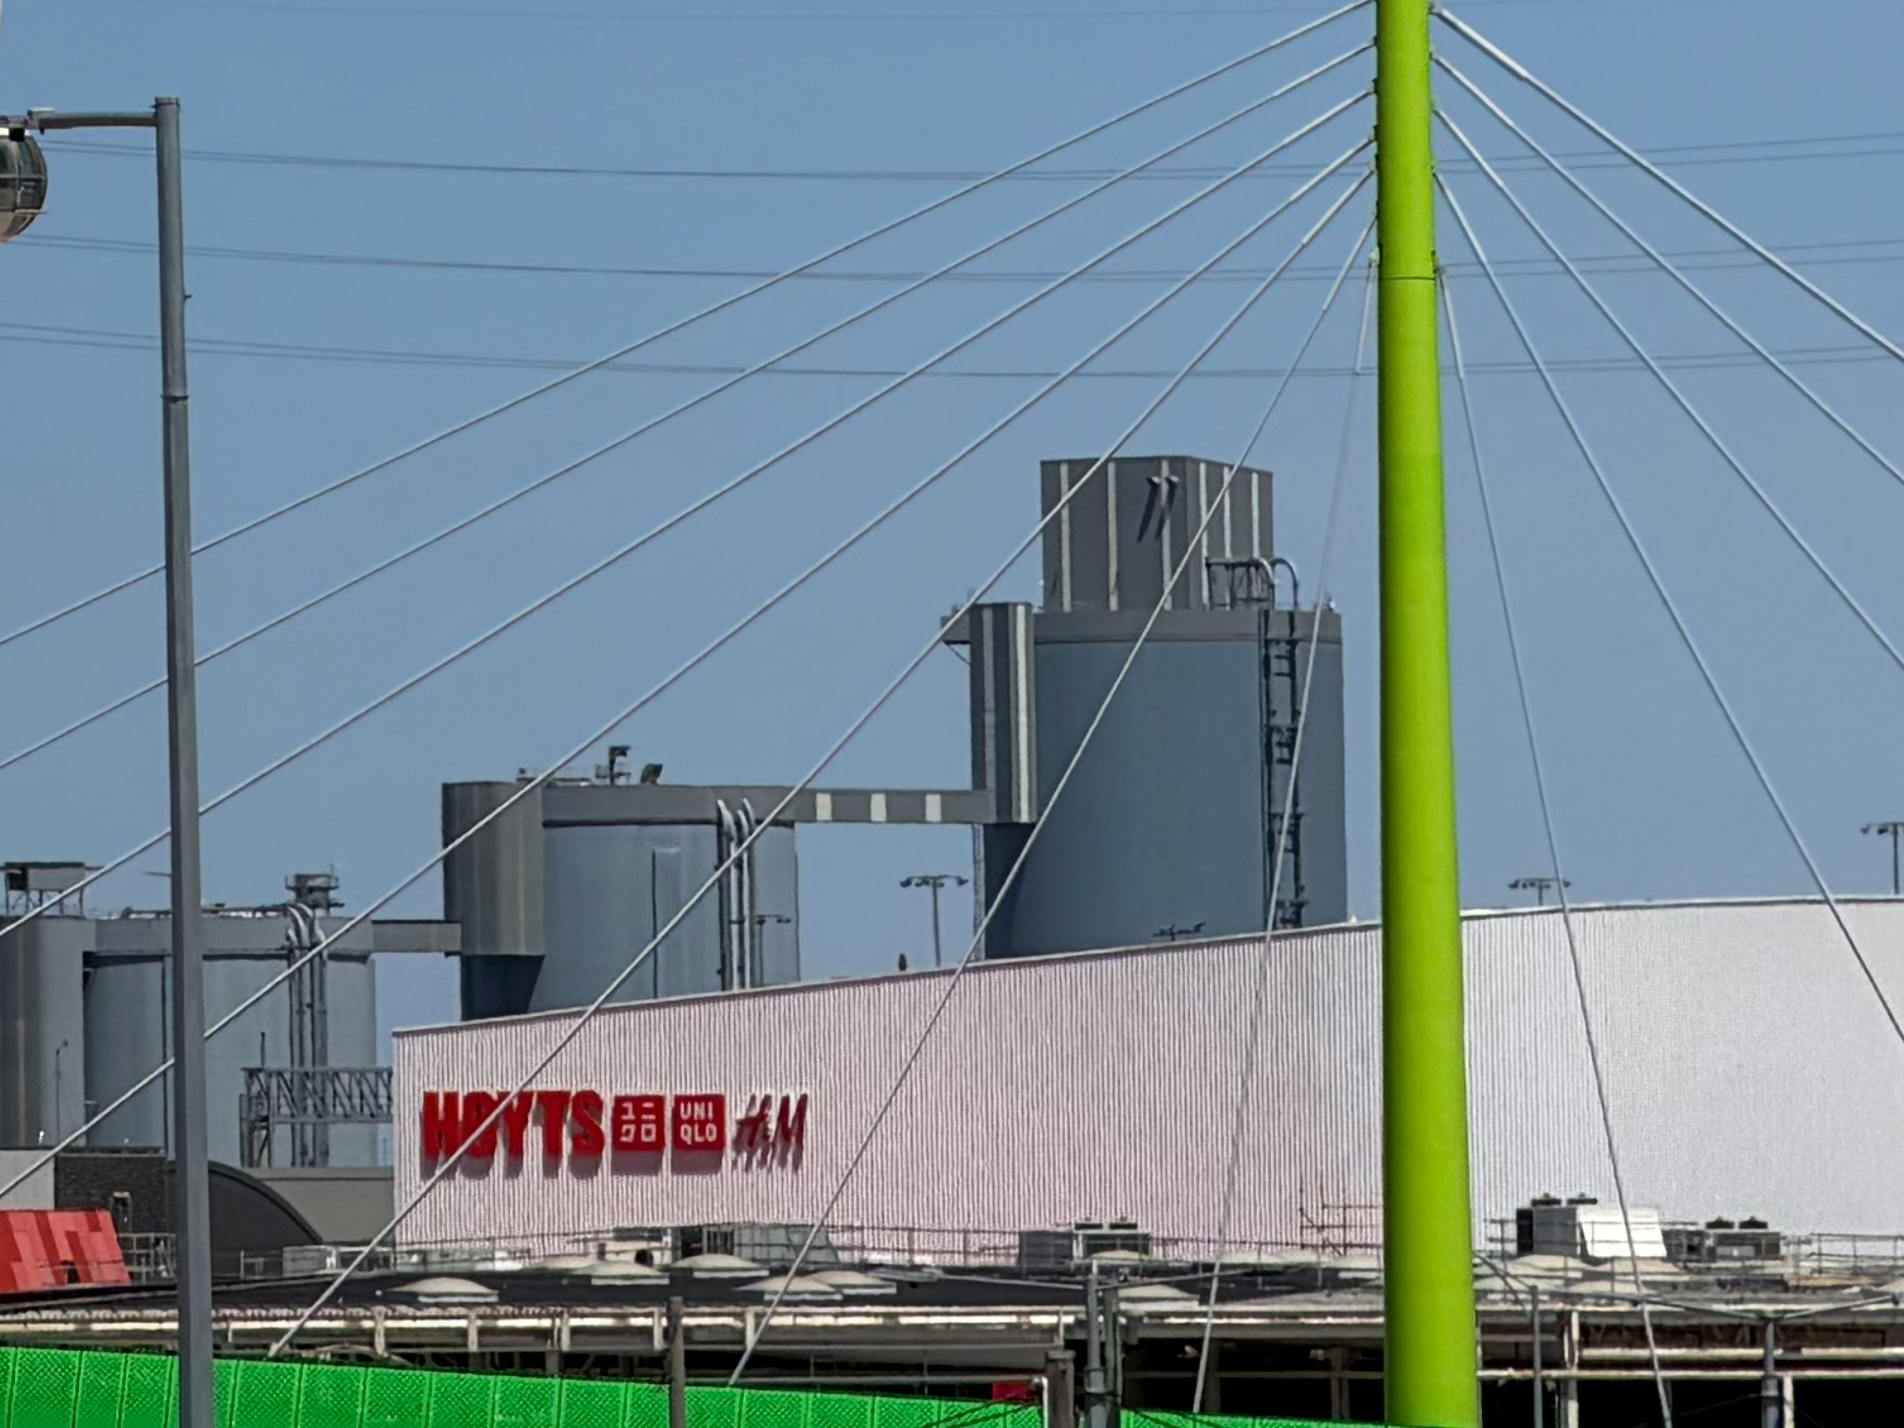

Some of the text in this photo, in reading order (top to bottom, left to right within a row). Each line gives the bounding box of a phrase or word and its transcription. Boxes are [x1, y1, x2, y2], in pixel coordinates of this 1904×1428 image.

[423, 1089, 605, 1160] HOYTS
[679, 1101, 714, 1120] UNI
[735, 1092, 808, 1147] H&M
[679, 1123, 718, 1144] QLO
